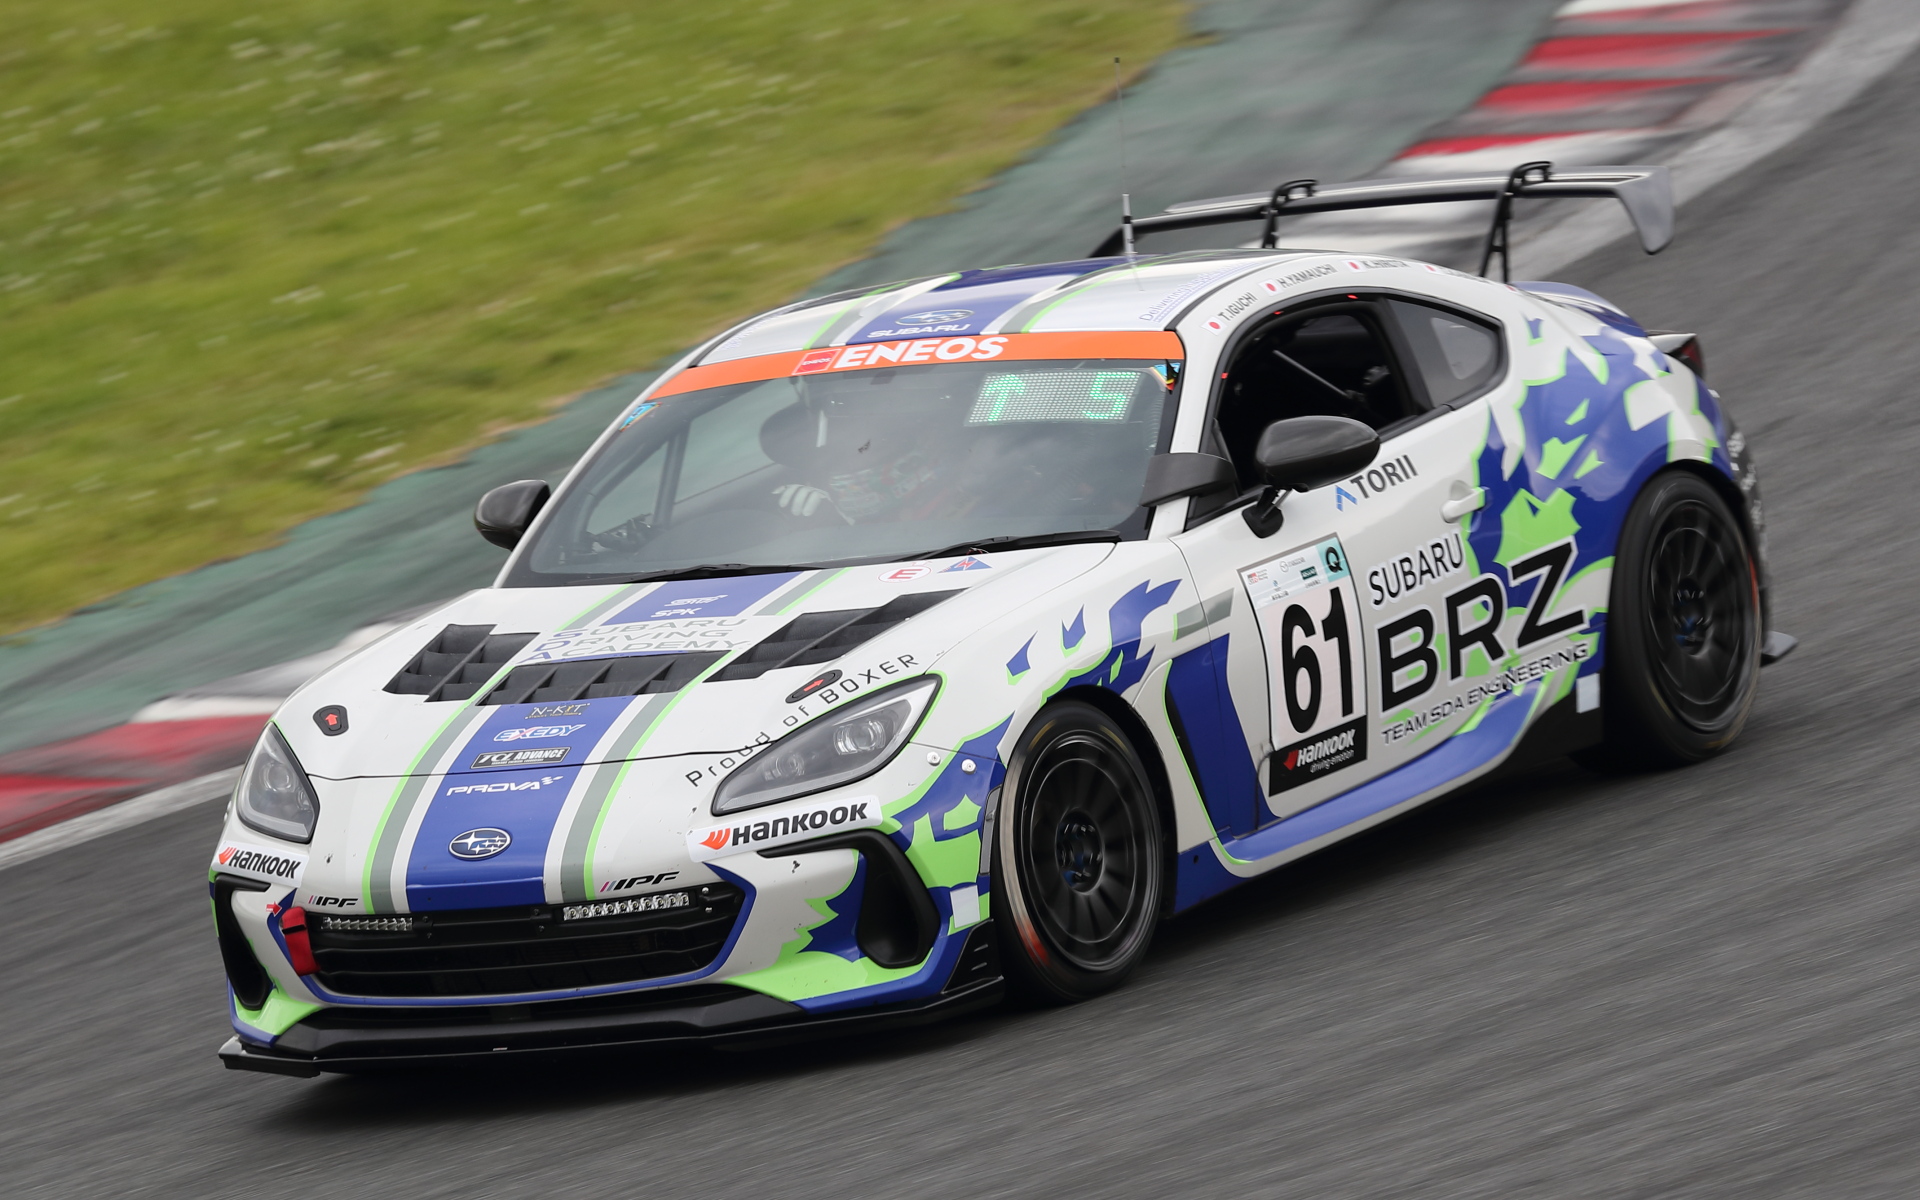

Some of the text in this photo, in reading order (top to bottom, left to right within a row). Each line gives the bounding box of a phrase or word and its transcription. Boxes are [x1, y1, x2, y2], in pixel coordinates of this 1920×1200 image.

[1218, 291, 1258, 321] T.IGUCHI
[867, 324, 971, 338] SUBARU
[833, 337, 1009, 369] ENEOS
[1350, 454, 1418, 499] TORII
[1326, 546, 1343, 573] Q
[1369, 533, 1463, 606] SUBARU
[650, 607, 702, 618] SPK
[548, 618, 747, 641] SUBARU
[1377, 541, 1585, 713] BRZ
[519, 640, 750, 664] ACADEMY
[533, 629, 733, 652] DRIVING
[1281, 586, 1354, 733] 61
[1381, 643, 1589, 745] TEAM SDA ENGINEERING
[494, 723, 586, 741] EXEDY
[685, 653, 919, 787] Proud of BOXER
[513, 748, 566, 761] ADVANCE
[446, 781, 540, 796] PROVA
[613, 871, 680, 890] IPF
[316, 896, 358, 908] IPF
